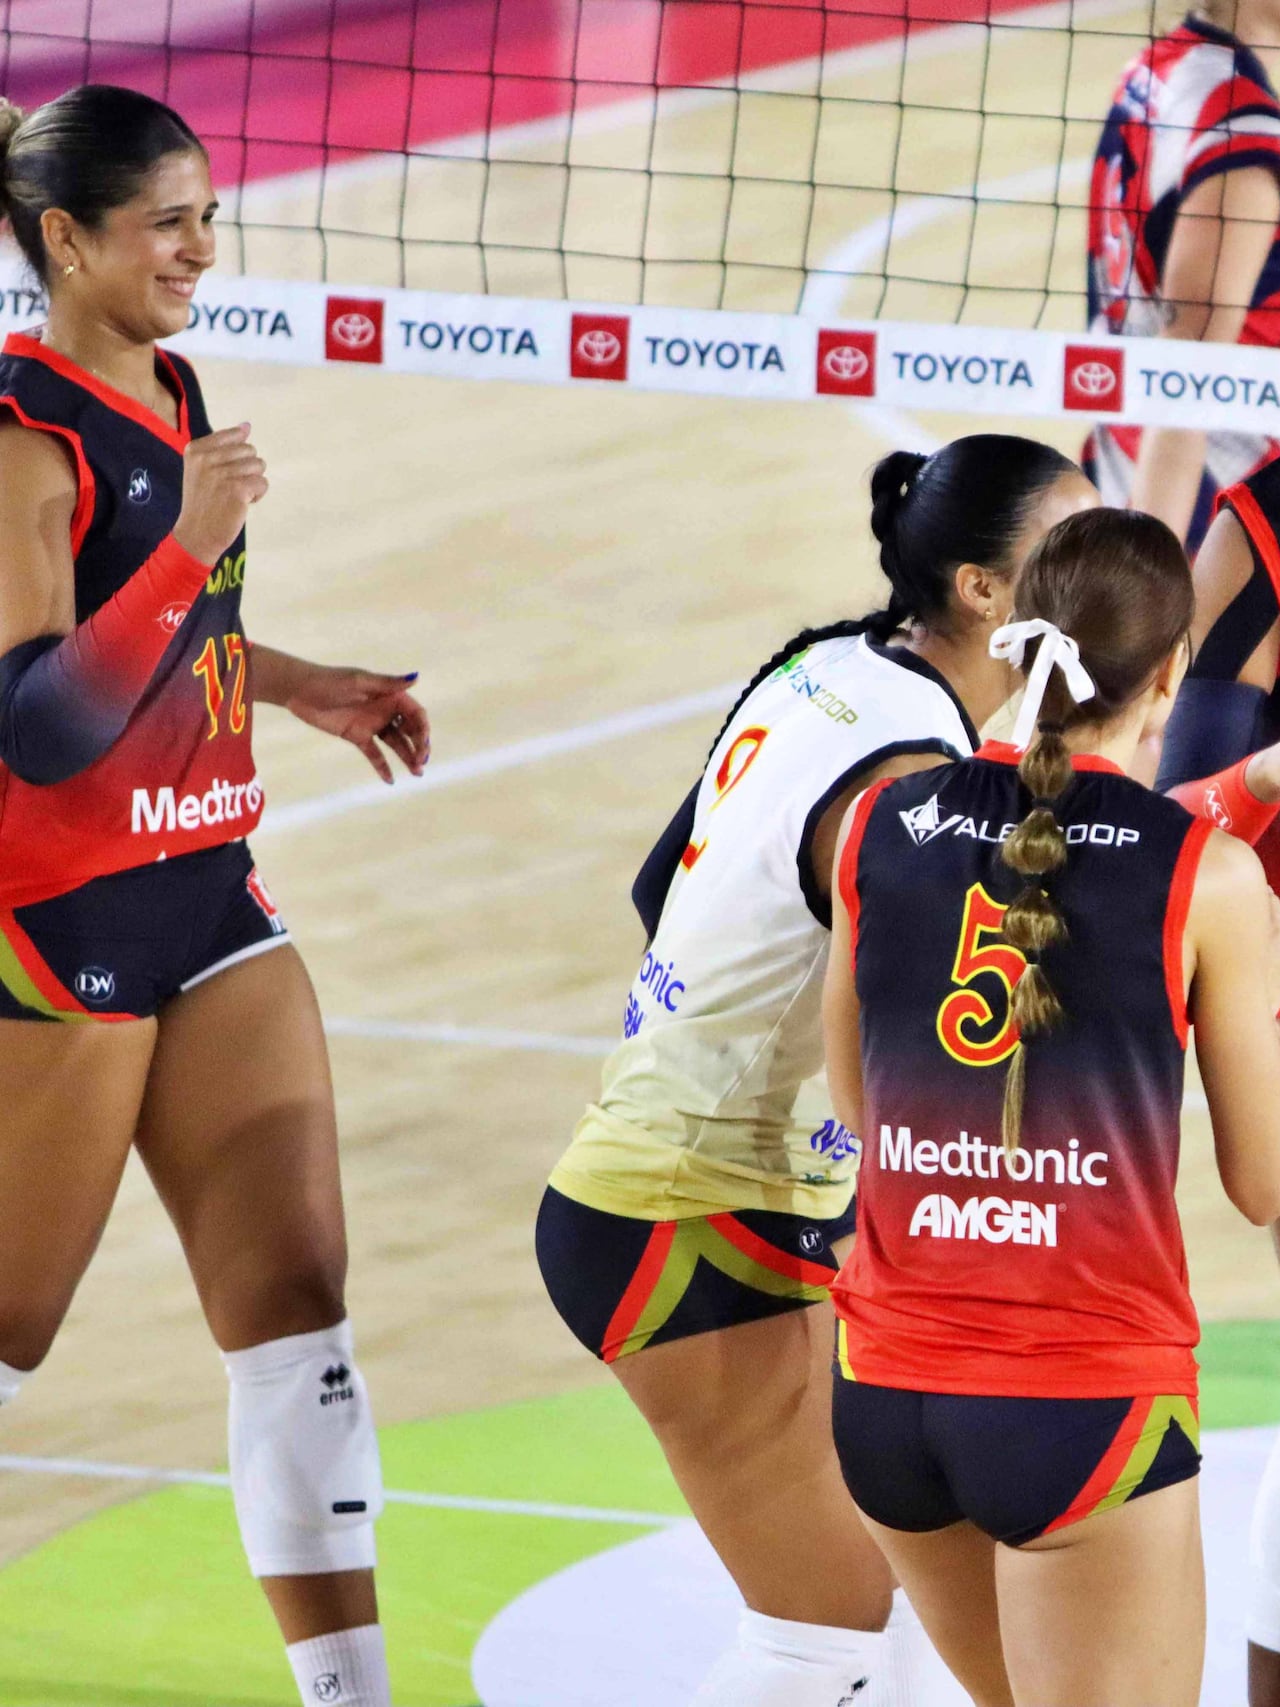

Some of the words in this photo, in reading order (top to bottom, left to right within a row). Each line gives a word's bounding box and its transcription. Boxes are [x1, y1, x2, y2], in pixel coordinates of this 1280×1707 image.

[400, 320, 539, 357] TOYOTA
[645, 336, 785, 373] TOYOTA
[893, 351, 1033, 389] TOYOTA
[131, 777, 264, 833] Medtro
[937, 882, 1028, 1067] 5
[880, 1124, 1108, 1186] Medtronic
[908, 1194, 1058, 1248] AMGEN
